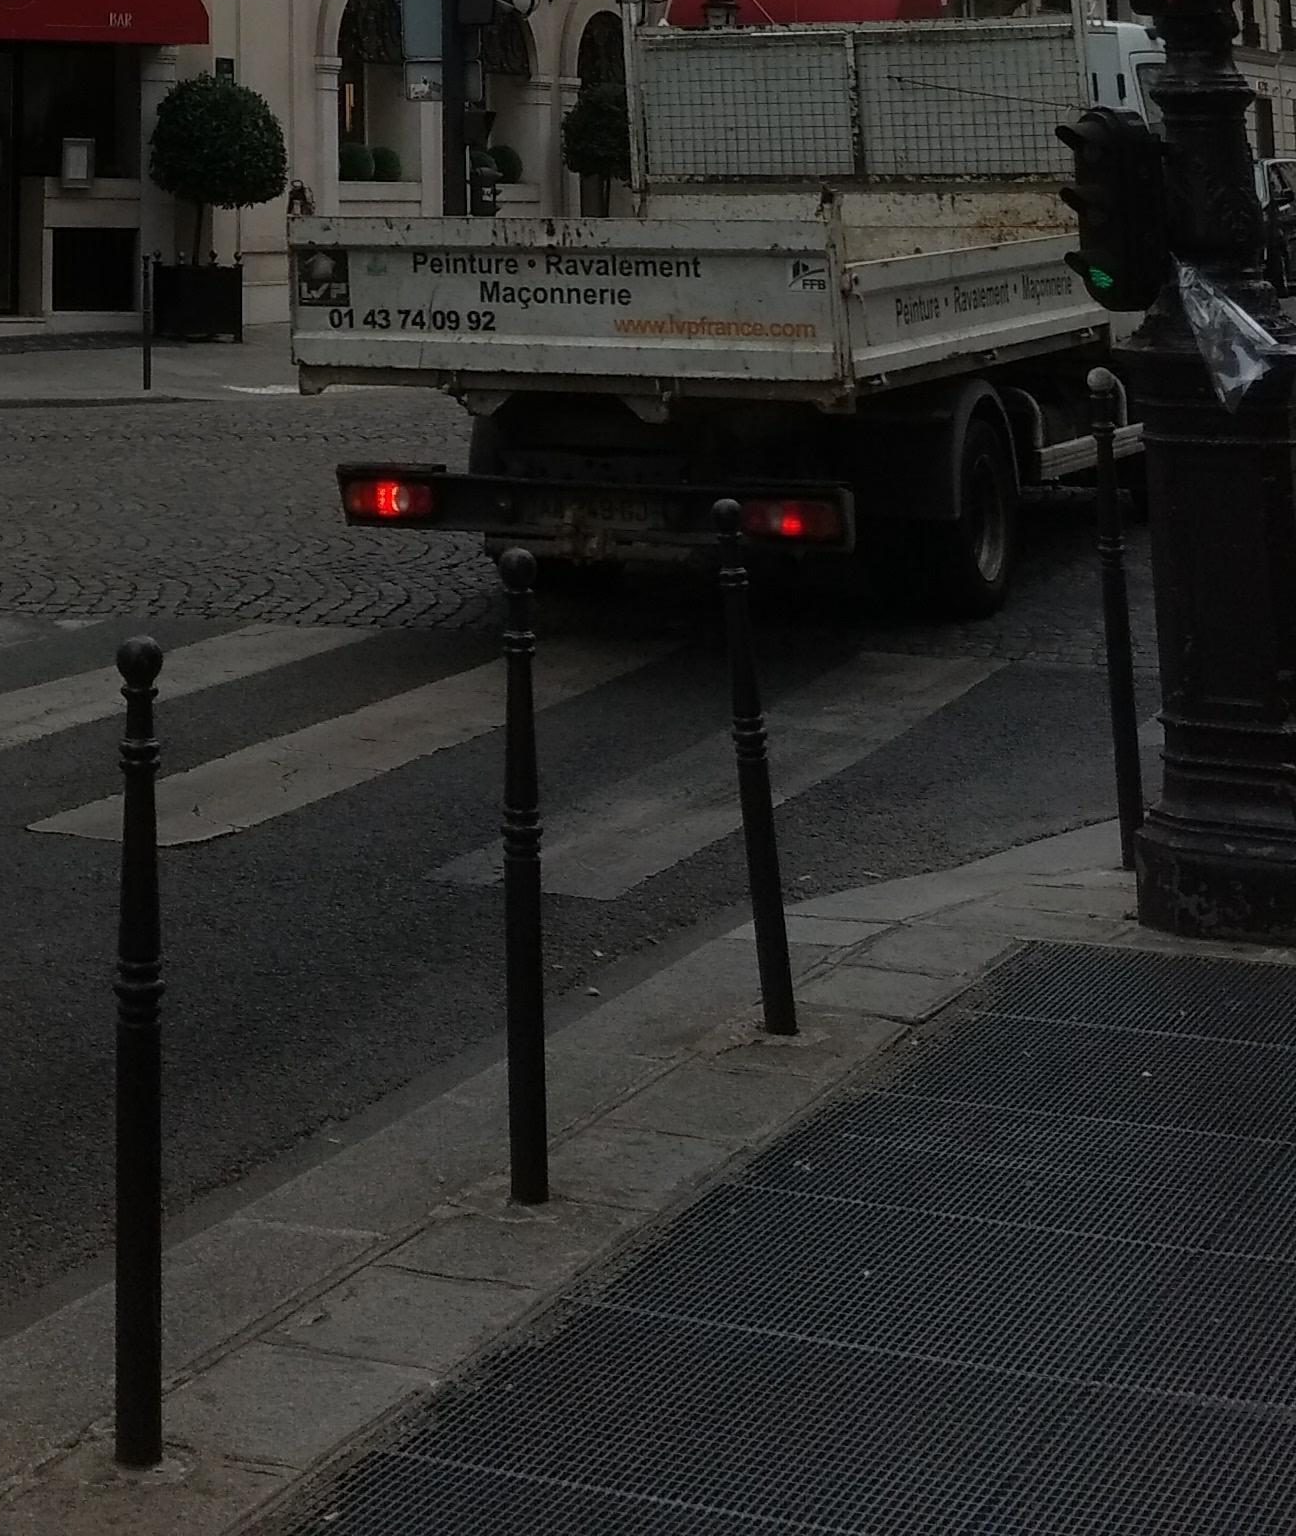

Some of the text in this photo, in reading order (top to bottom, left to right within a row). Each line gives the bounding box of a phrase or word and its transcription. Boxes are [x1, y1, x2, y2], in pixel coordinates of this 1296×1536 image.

[109, 11, 133, 27] BAR
[412, 251, 702, 278] Peinture Ravalement
[479, 280, 632, 309] Maçonnerie
[801, 279, 827, 291] FFB
[895, 271, 1073, 327] Peinture Ravalement Maçonnerie
[329, 308, 497, 332] 01 43 74 09 92
[613, 316, 817, 339] www.lvpfrance.com
